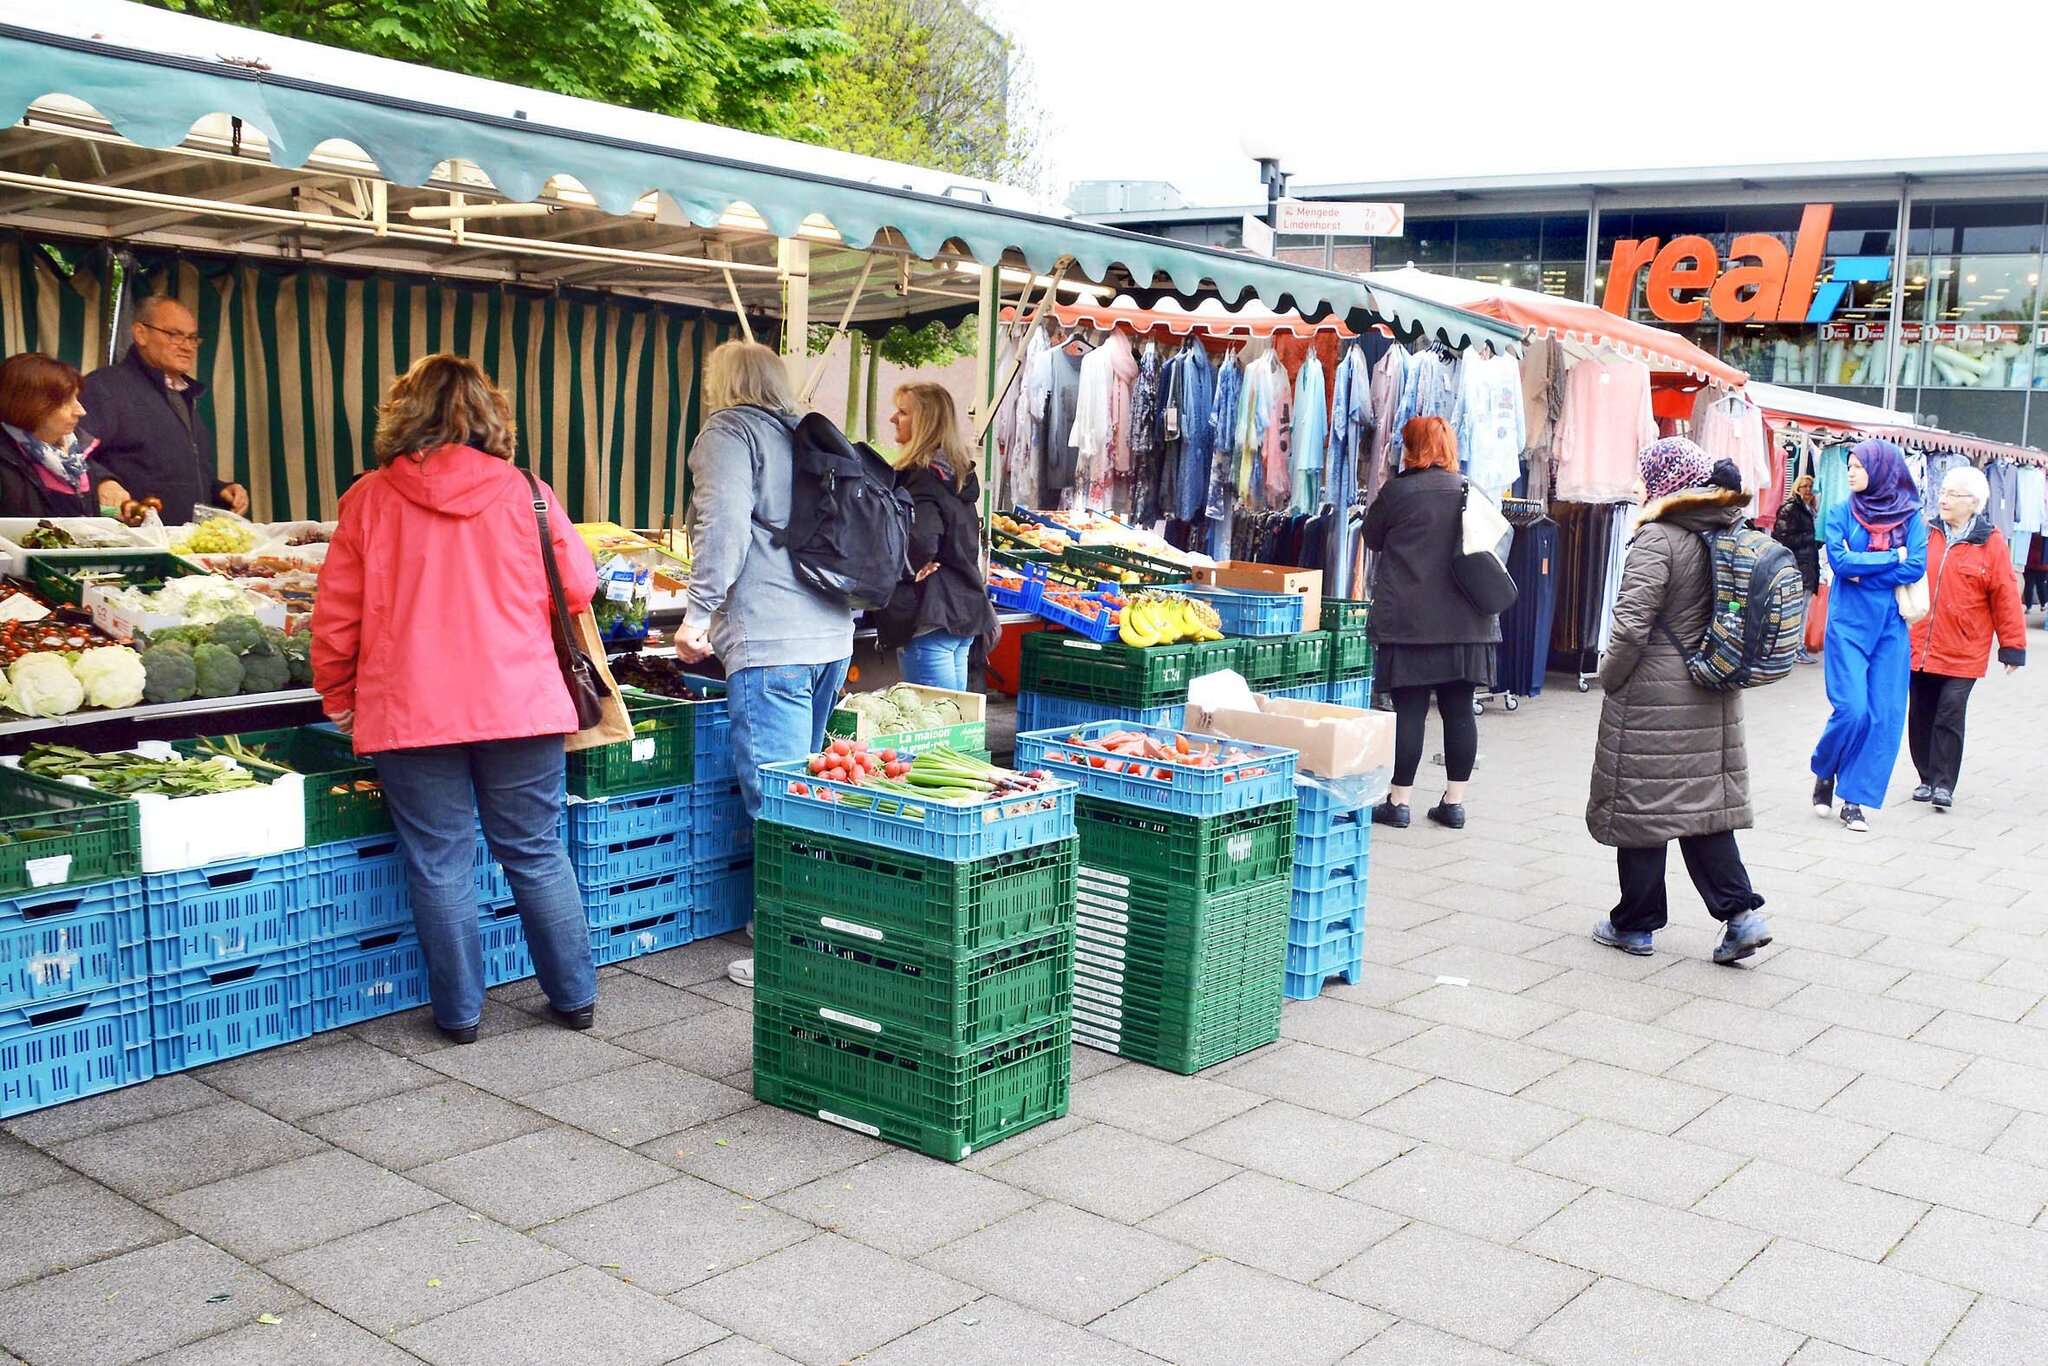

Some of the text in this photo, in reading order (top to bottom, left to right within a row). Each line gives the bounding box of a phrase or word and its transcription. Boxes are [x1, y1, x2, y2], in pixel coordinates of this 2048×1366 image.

[1296, 207, 1340, 218] Mengede
[1283, 220, 1341, 230] Lindenhorst
[898, 732, 912, 745] La
[914, 728, 951, 742] maison
